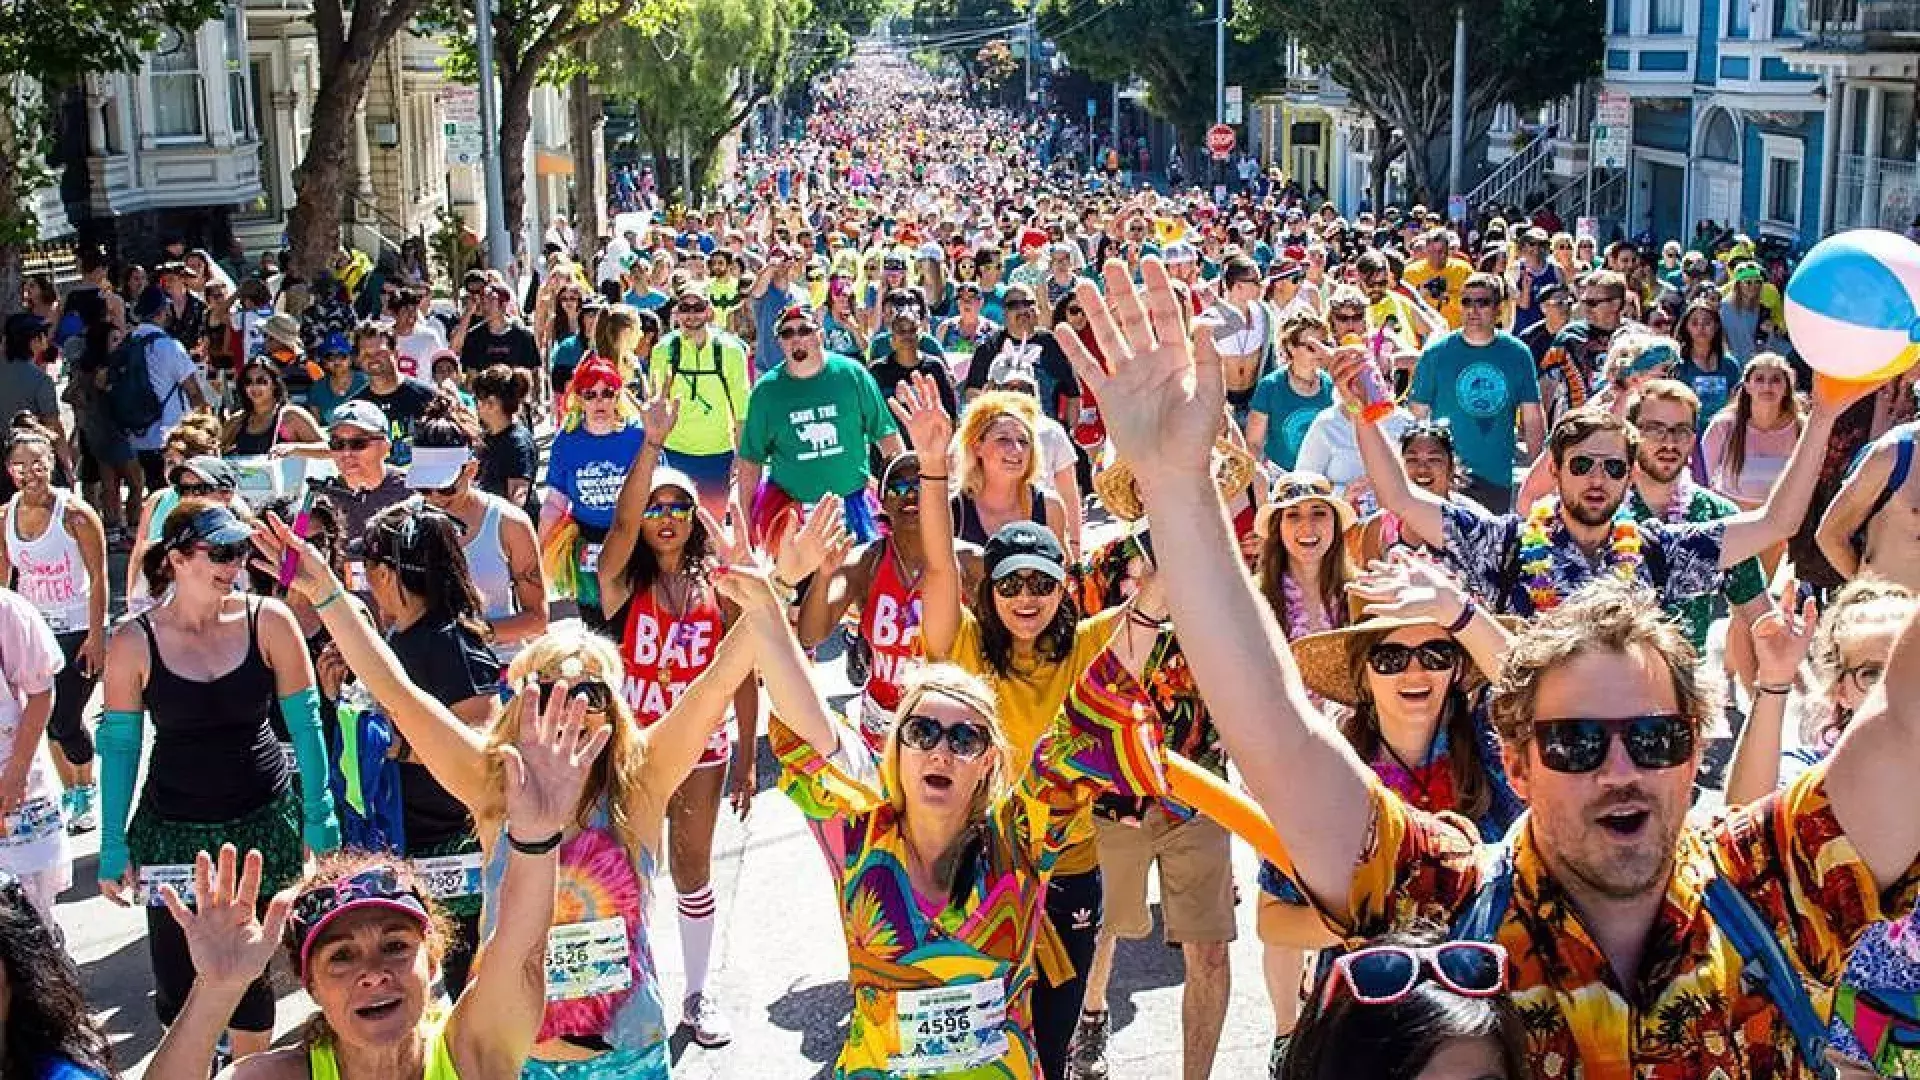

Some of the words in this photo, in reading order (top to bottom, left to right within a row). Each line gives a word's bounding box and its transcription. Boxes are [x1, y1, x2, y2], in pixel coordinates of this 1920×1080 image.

[1211, 133, 1233, 145] STOP
[634, 613, 712, 668] BAE
[918, 1016, 971, 1034] 4596
